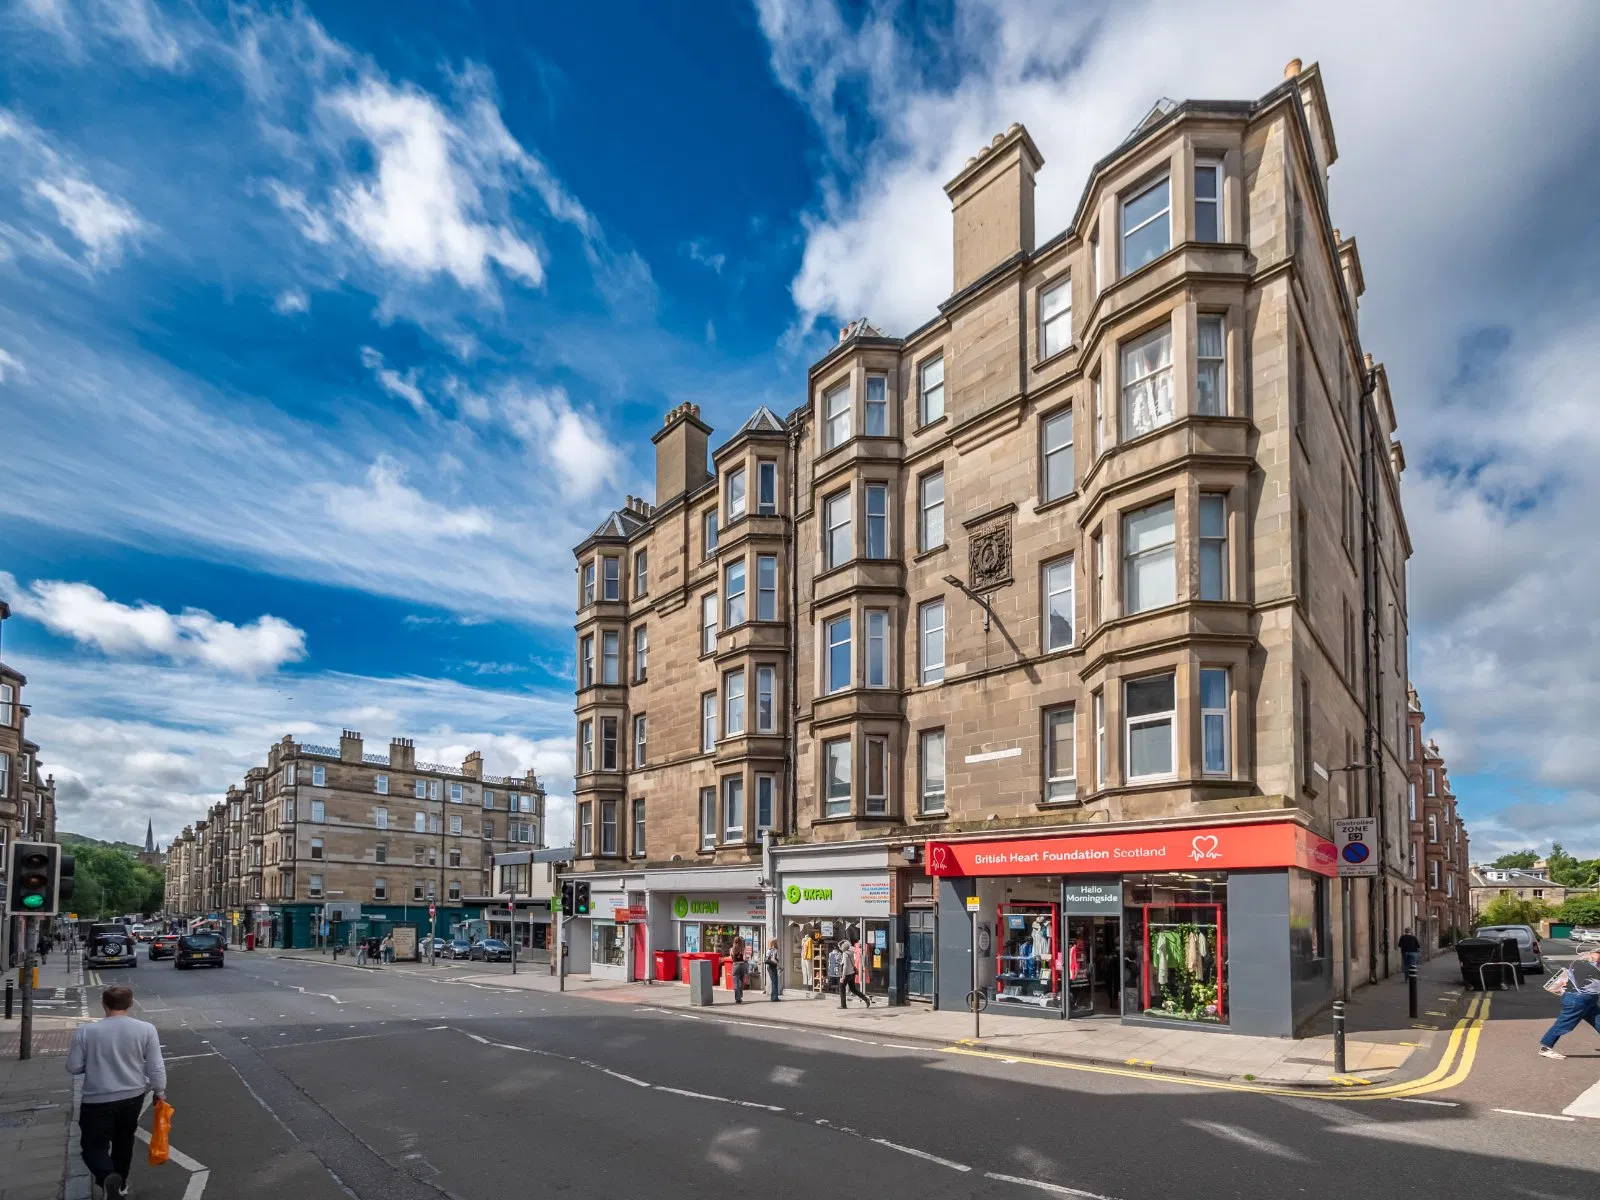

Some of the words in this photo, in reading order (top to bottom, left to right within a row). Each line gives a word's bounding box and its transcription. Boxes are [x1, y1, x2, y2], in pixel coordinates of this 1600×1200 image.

[1349, 833, 1362, 841] S2
[975, 853, 1007, 865] British
[1009, 851, 1039, 864] Heart
[1042, 849, 1110, 862] Foundation
[1113, 845, 1167, 859] Scotland
[803, 888, 833, 901] OXFAM
[1080, 886, 1103, 894] Hello
[1066, 894, 1119, 904] Morningside
[690, 899, 719, 914] OXFAM
